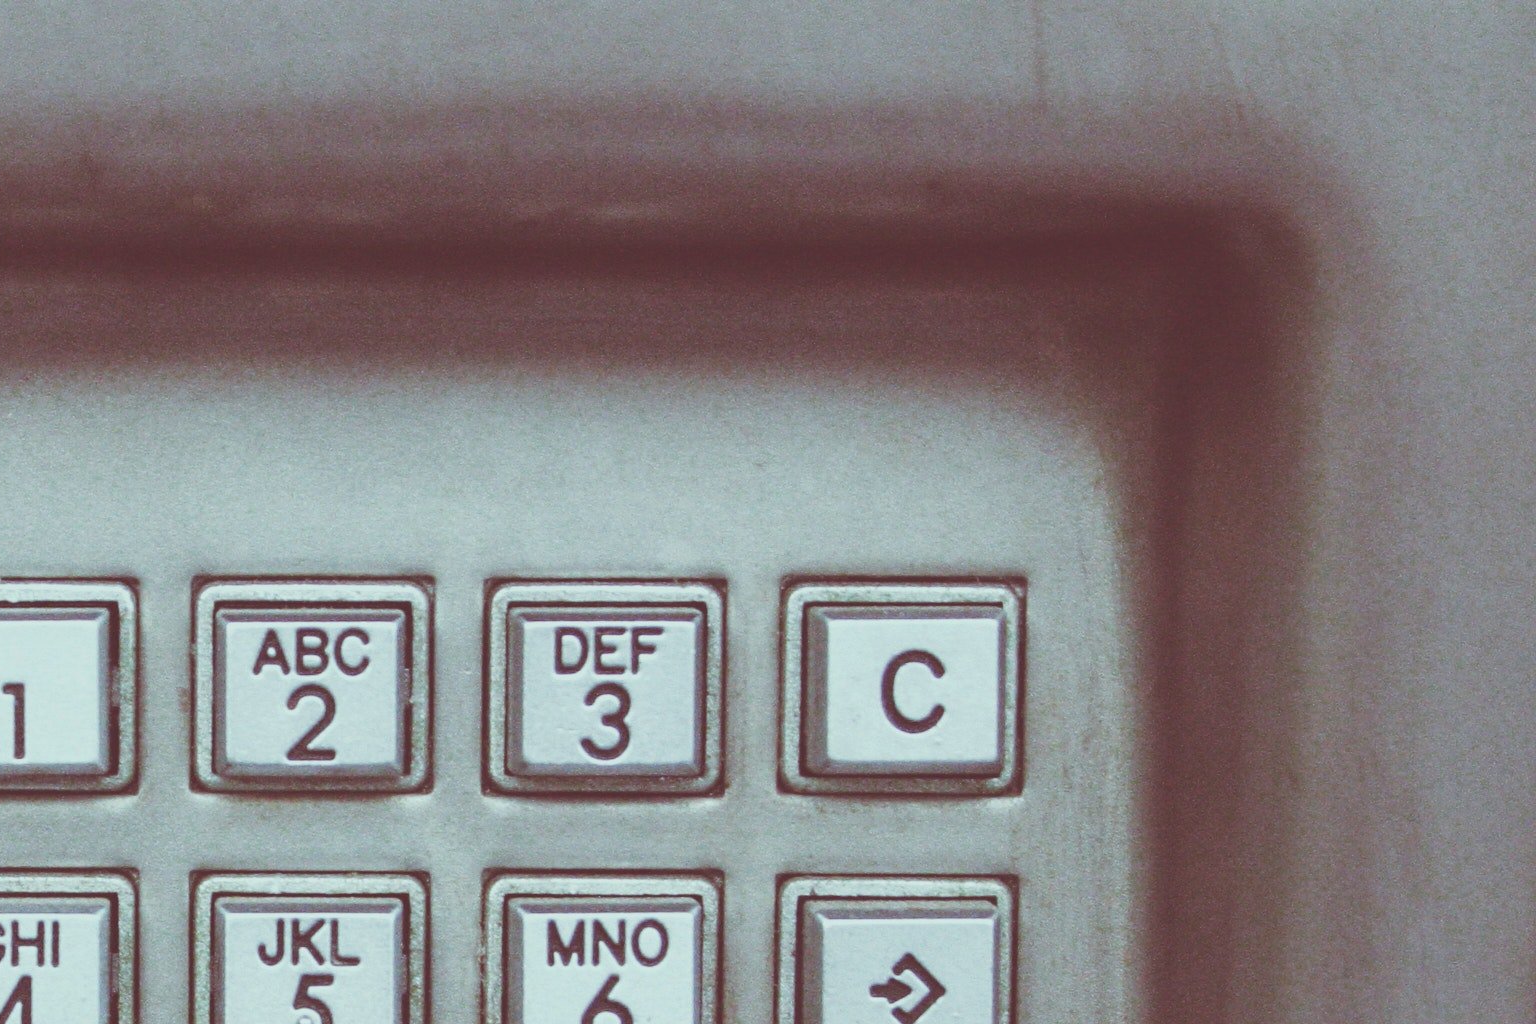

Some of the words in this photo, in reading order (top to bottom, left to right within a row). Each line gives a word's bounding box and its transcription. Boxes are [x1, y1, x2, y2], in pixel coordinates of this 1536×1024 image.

[253, 627, 371, 677] ABC
[554, 625, 664, 675] DEF
[0, 682, 27, 760] 1
[285, 682, 337, 762] 2
[579, 682, 632, 761] 3
[881, 649, 945, 733] C
[257, 917, 361, 967] JKL
[547, 919, 670, 967] MNO
